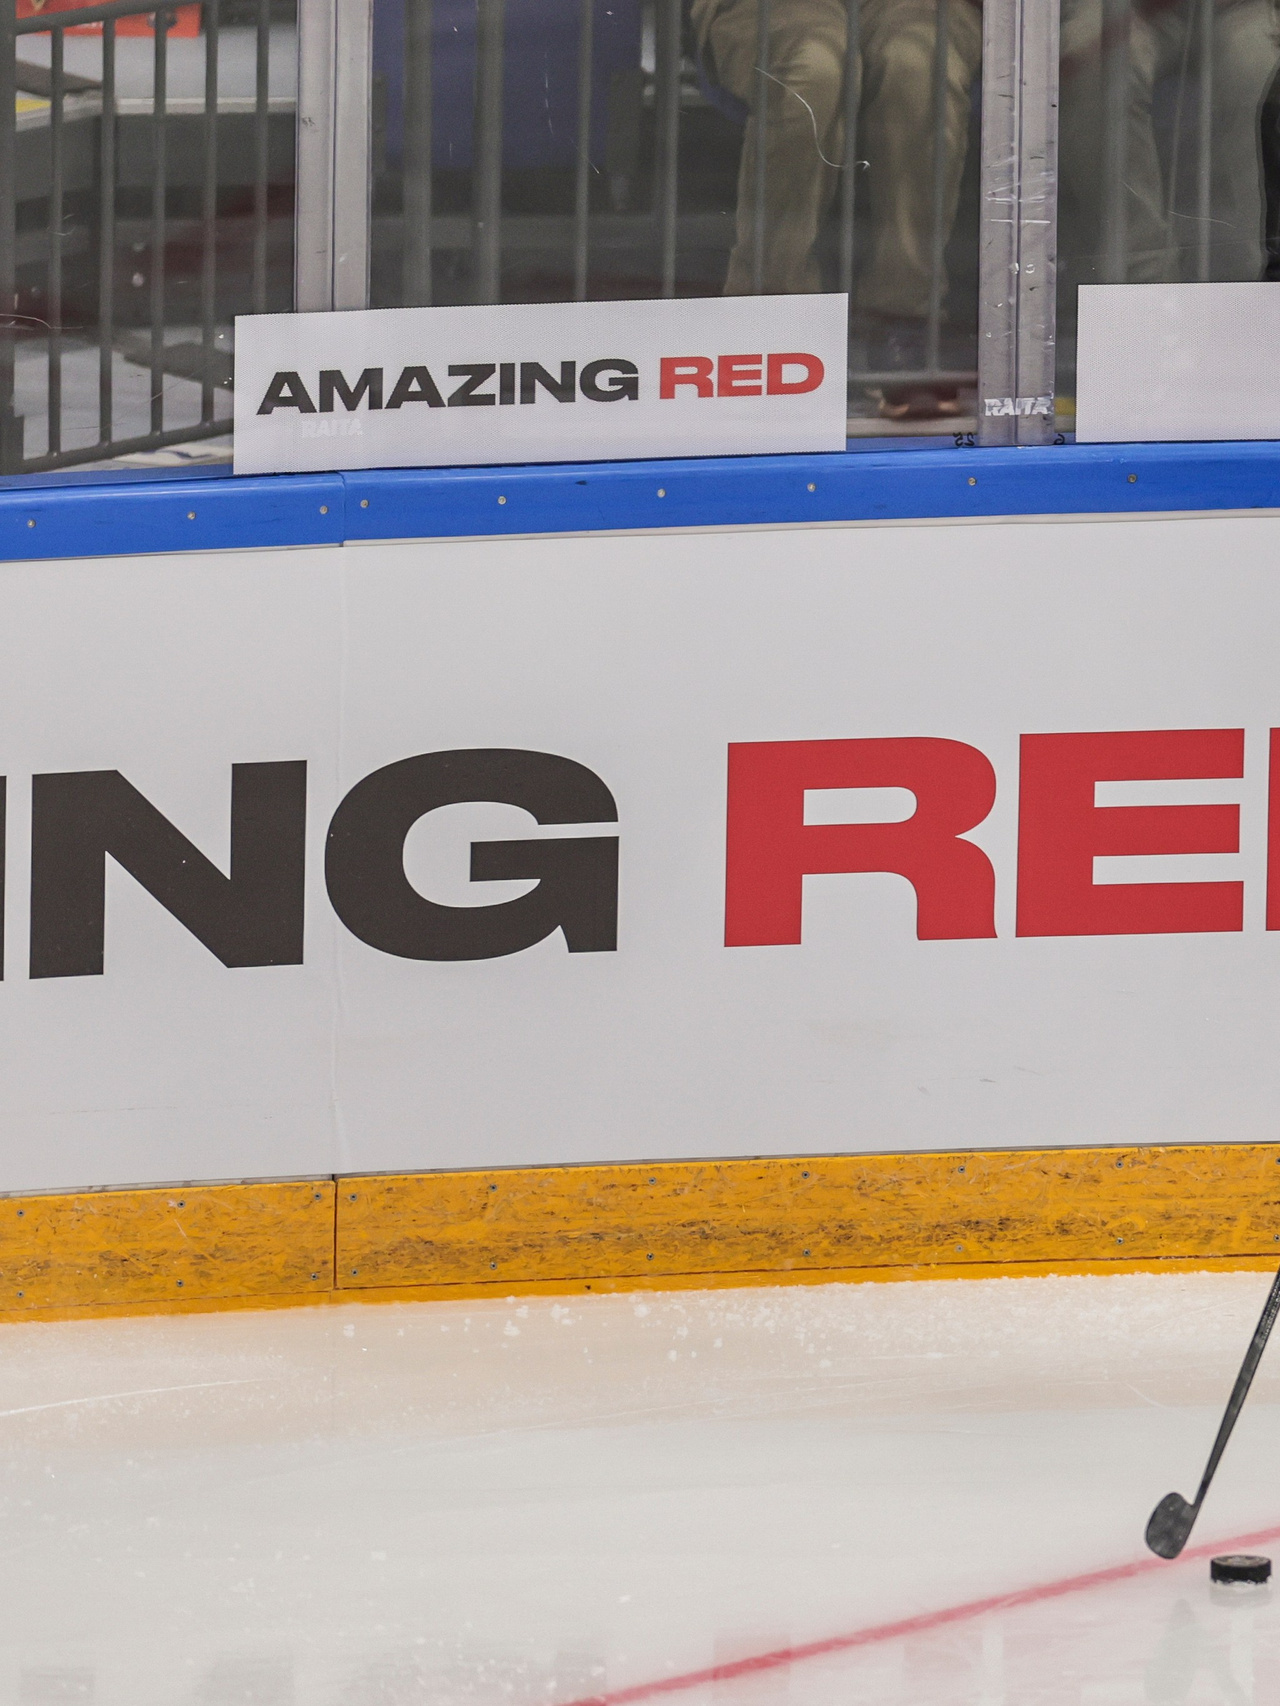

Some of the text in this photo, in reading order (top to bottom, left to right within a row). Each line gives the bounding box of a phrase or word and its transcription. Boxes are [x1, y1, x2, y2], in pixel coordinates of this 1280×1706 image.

[256, 352, 825, 415] AMAZING RED
[0, 748, 620, 982] NG
